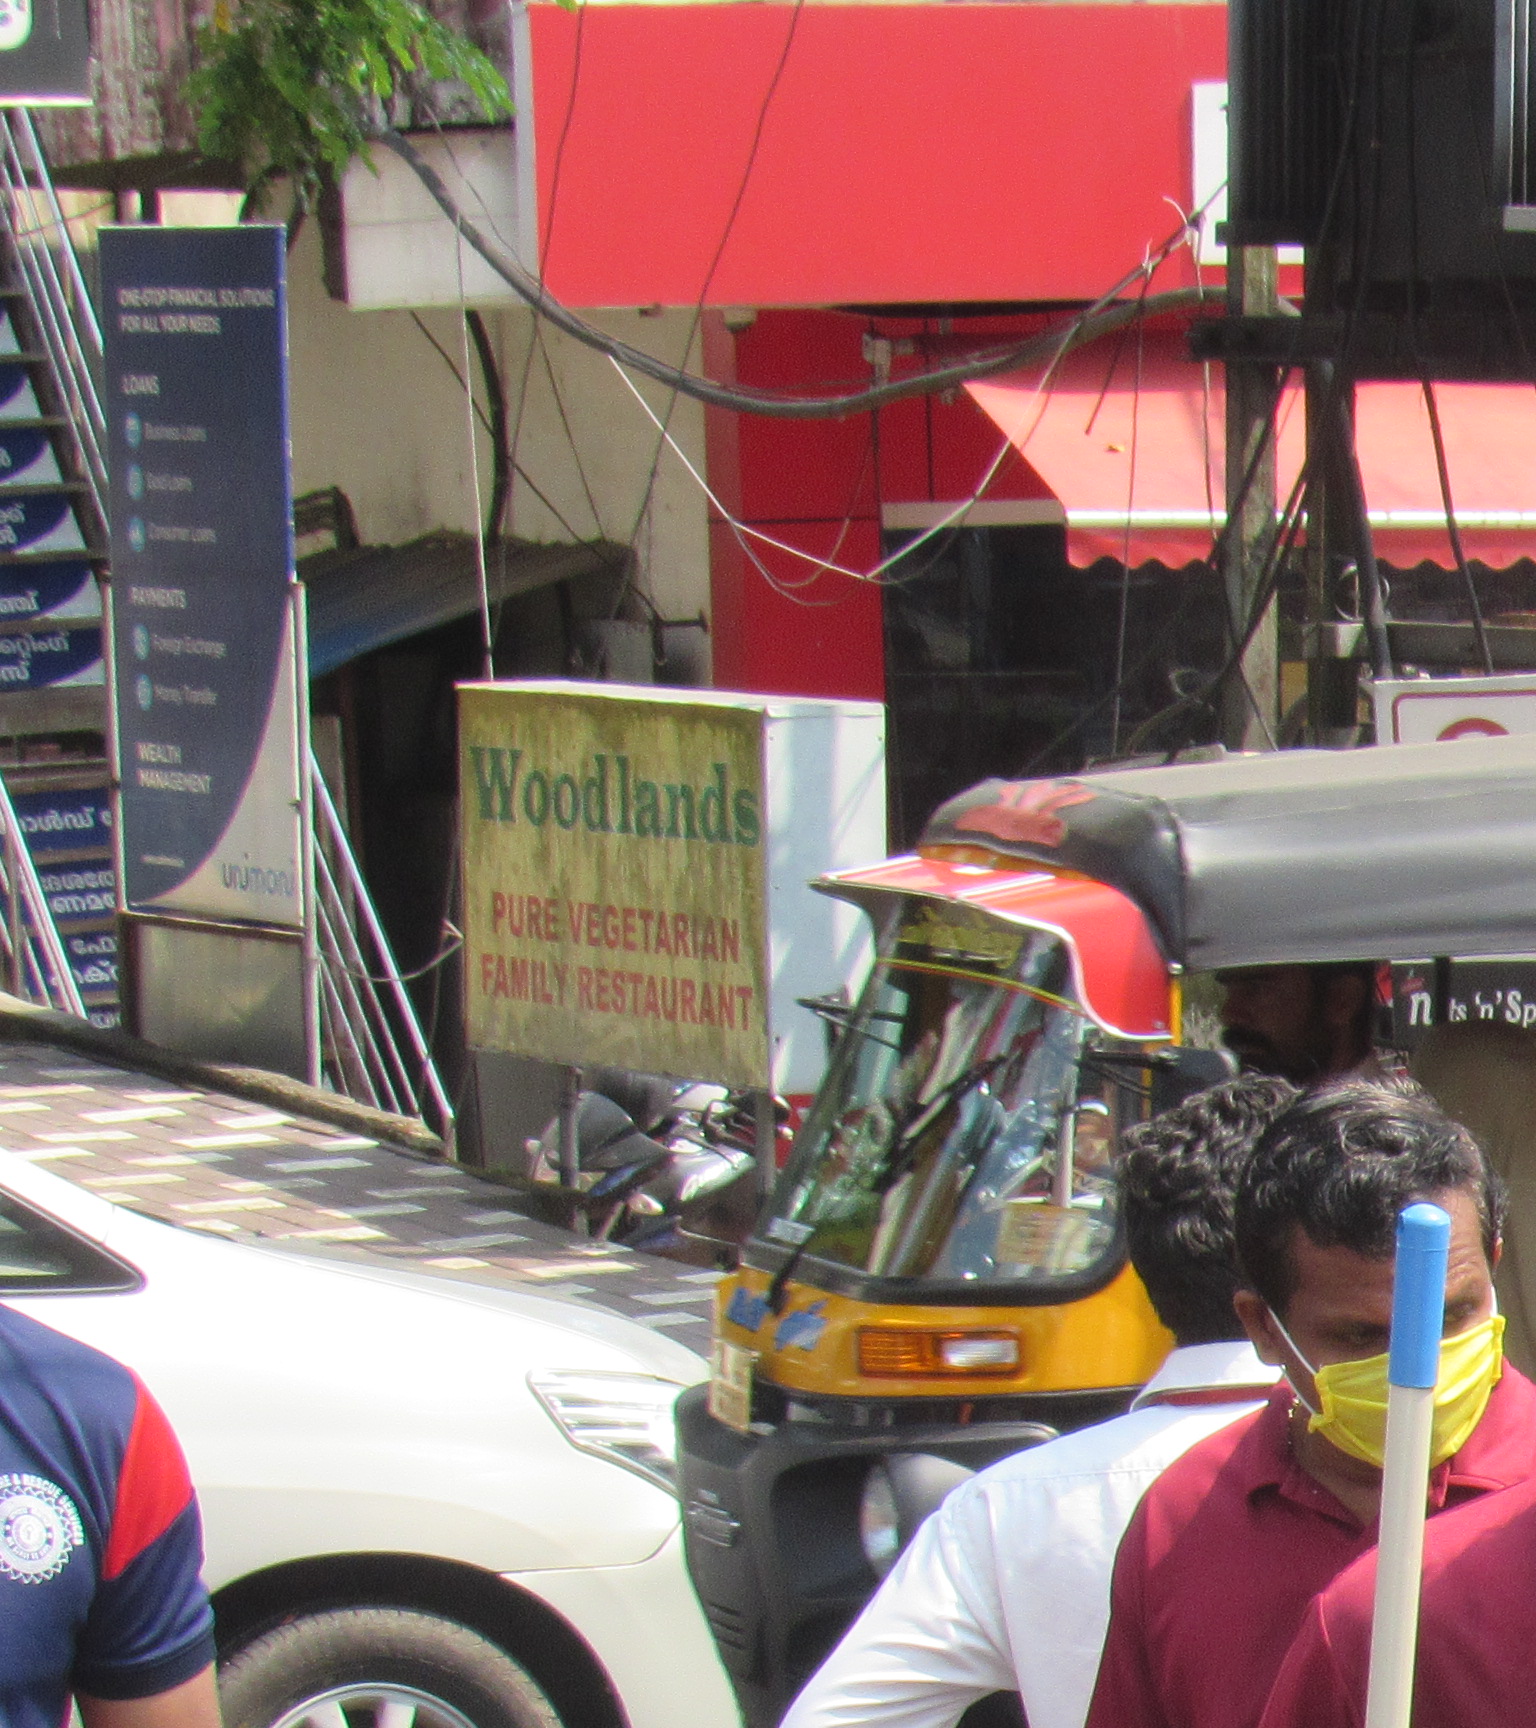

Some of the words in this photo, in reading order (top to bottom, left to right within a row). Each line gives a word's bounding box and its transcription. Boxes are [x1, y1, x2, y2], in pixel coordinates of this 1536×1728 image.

[122, 374, 160, 395] LOANS
[130, 586, 187, 610] PAYMENTS
[137, 742, 182, 764] WEALTH
[137, 769, 213, 794] MANAGEMENT
[470, 746, 760, 848] Woodlands
[493, 891, 558, 942] PURE
[567, 902, 740, 964] VEGETARIAN
[481, 953, 570, 1007] FAMILY
[578, 966, 753, 1031] RESTAURANT
[1409, 991, 1468, 1026] nts
[22, 1473, 64, 1499] RESCUE
